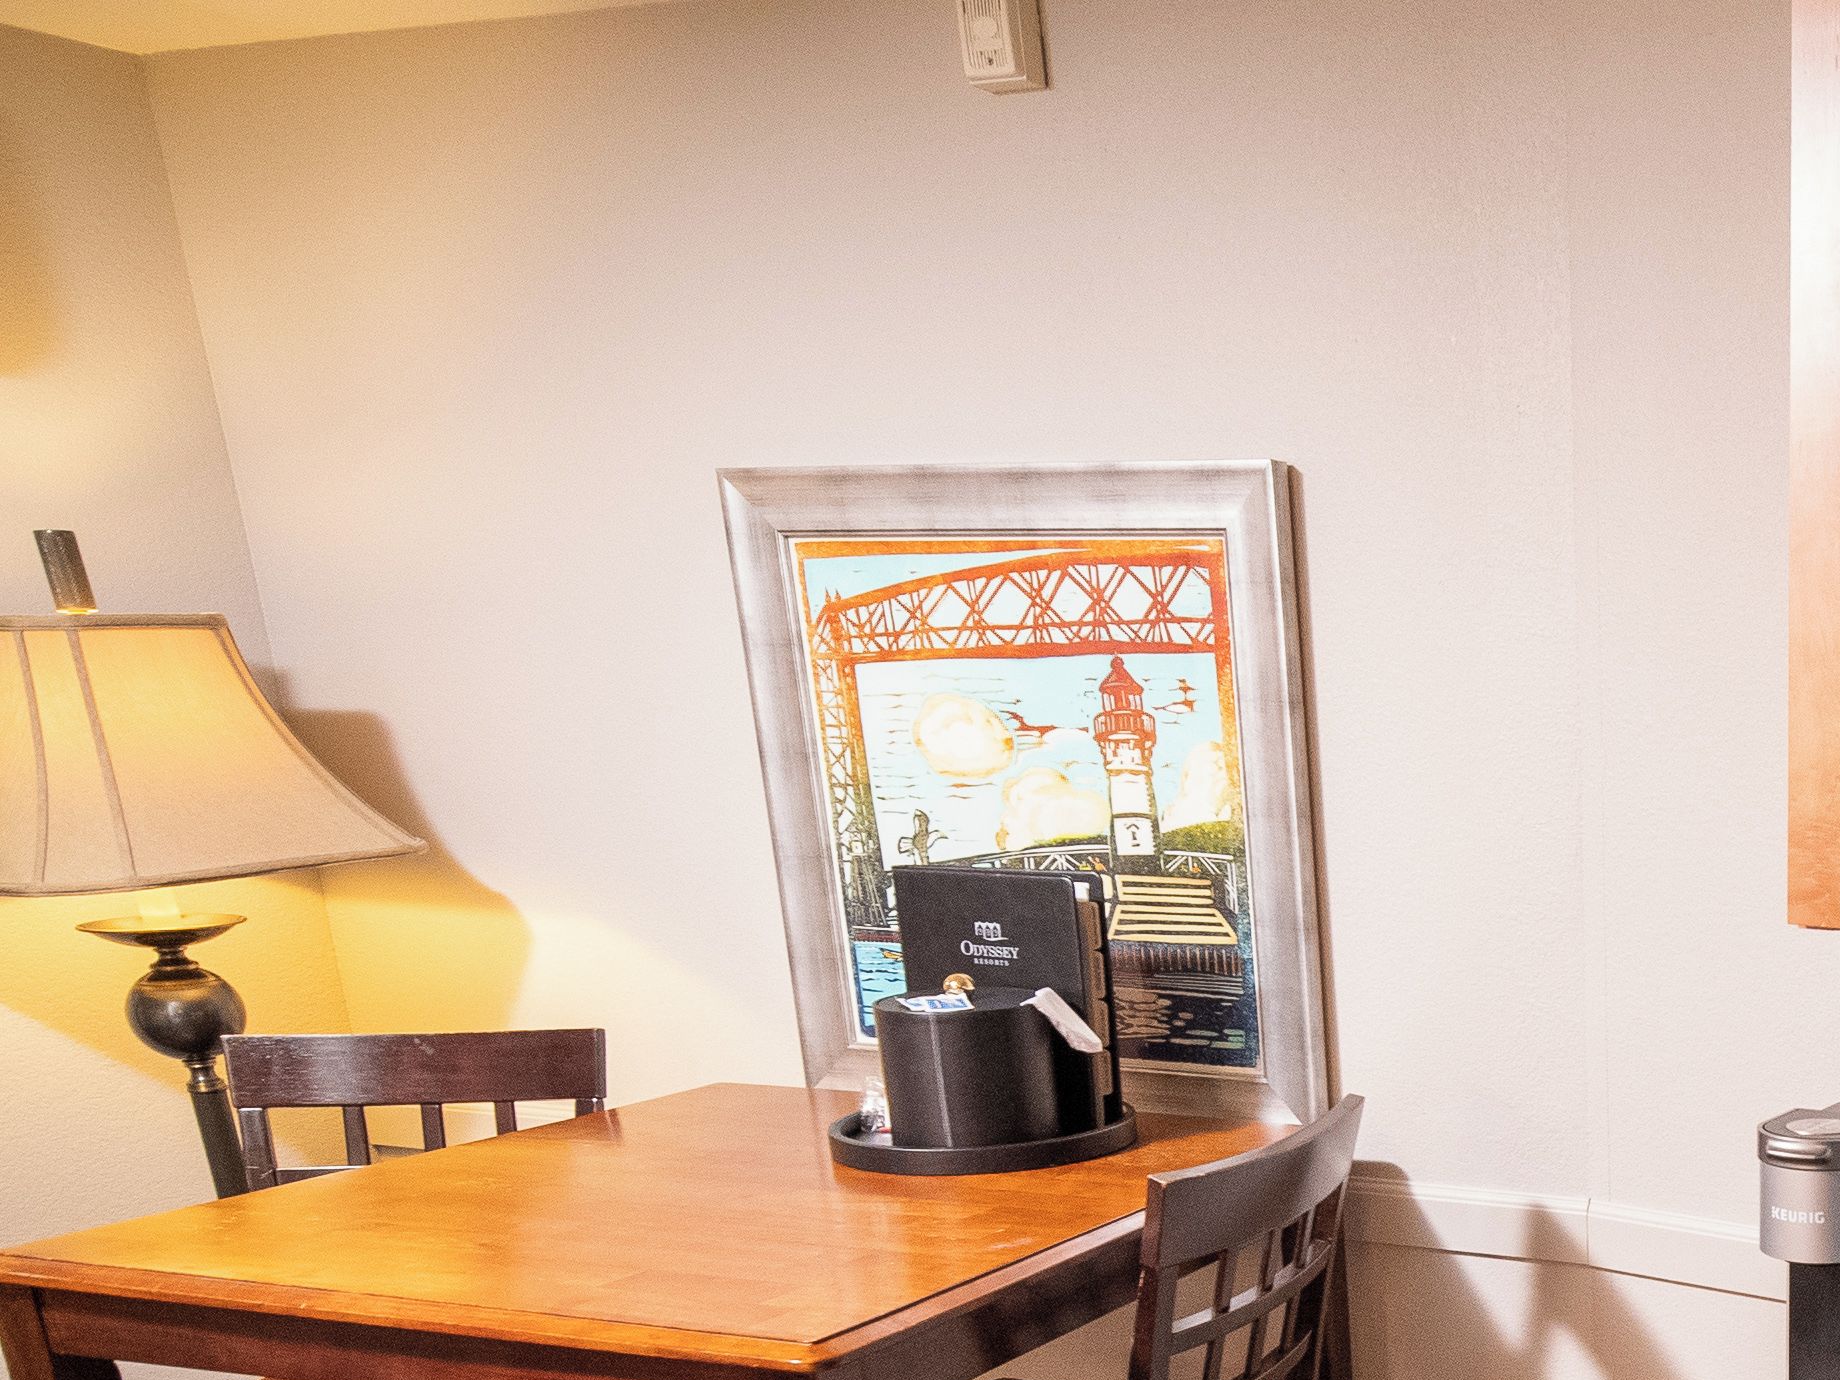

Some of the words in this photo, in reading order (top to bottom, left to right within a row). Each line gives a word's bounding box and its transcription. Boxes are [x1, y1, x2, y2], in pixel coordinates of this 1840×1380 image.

[960, 940, 1020, 959] ODYSSEY
[973, 957, 1010, 967] RESORTS
[1771, 1205, 1826, 1224] KEURIG
